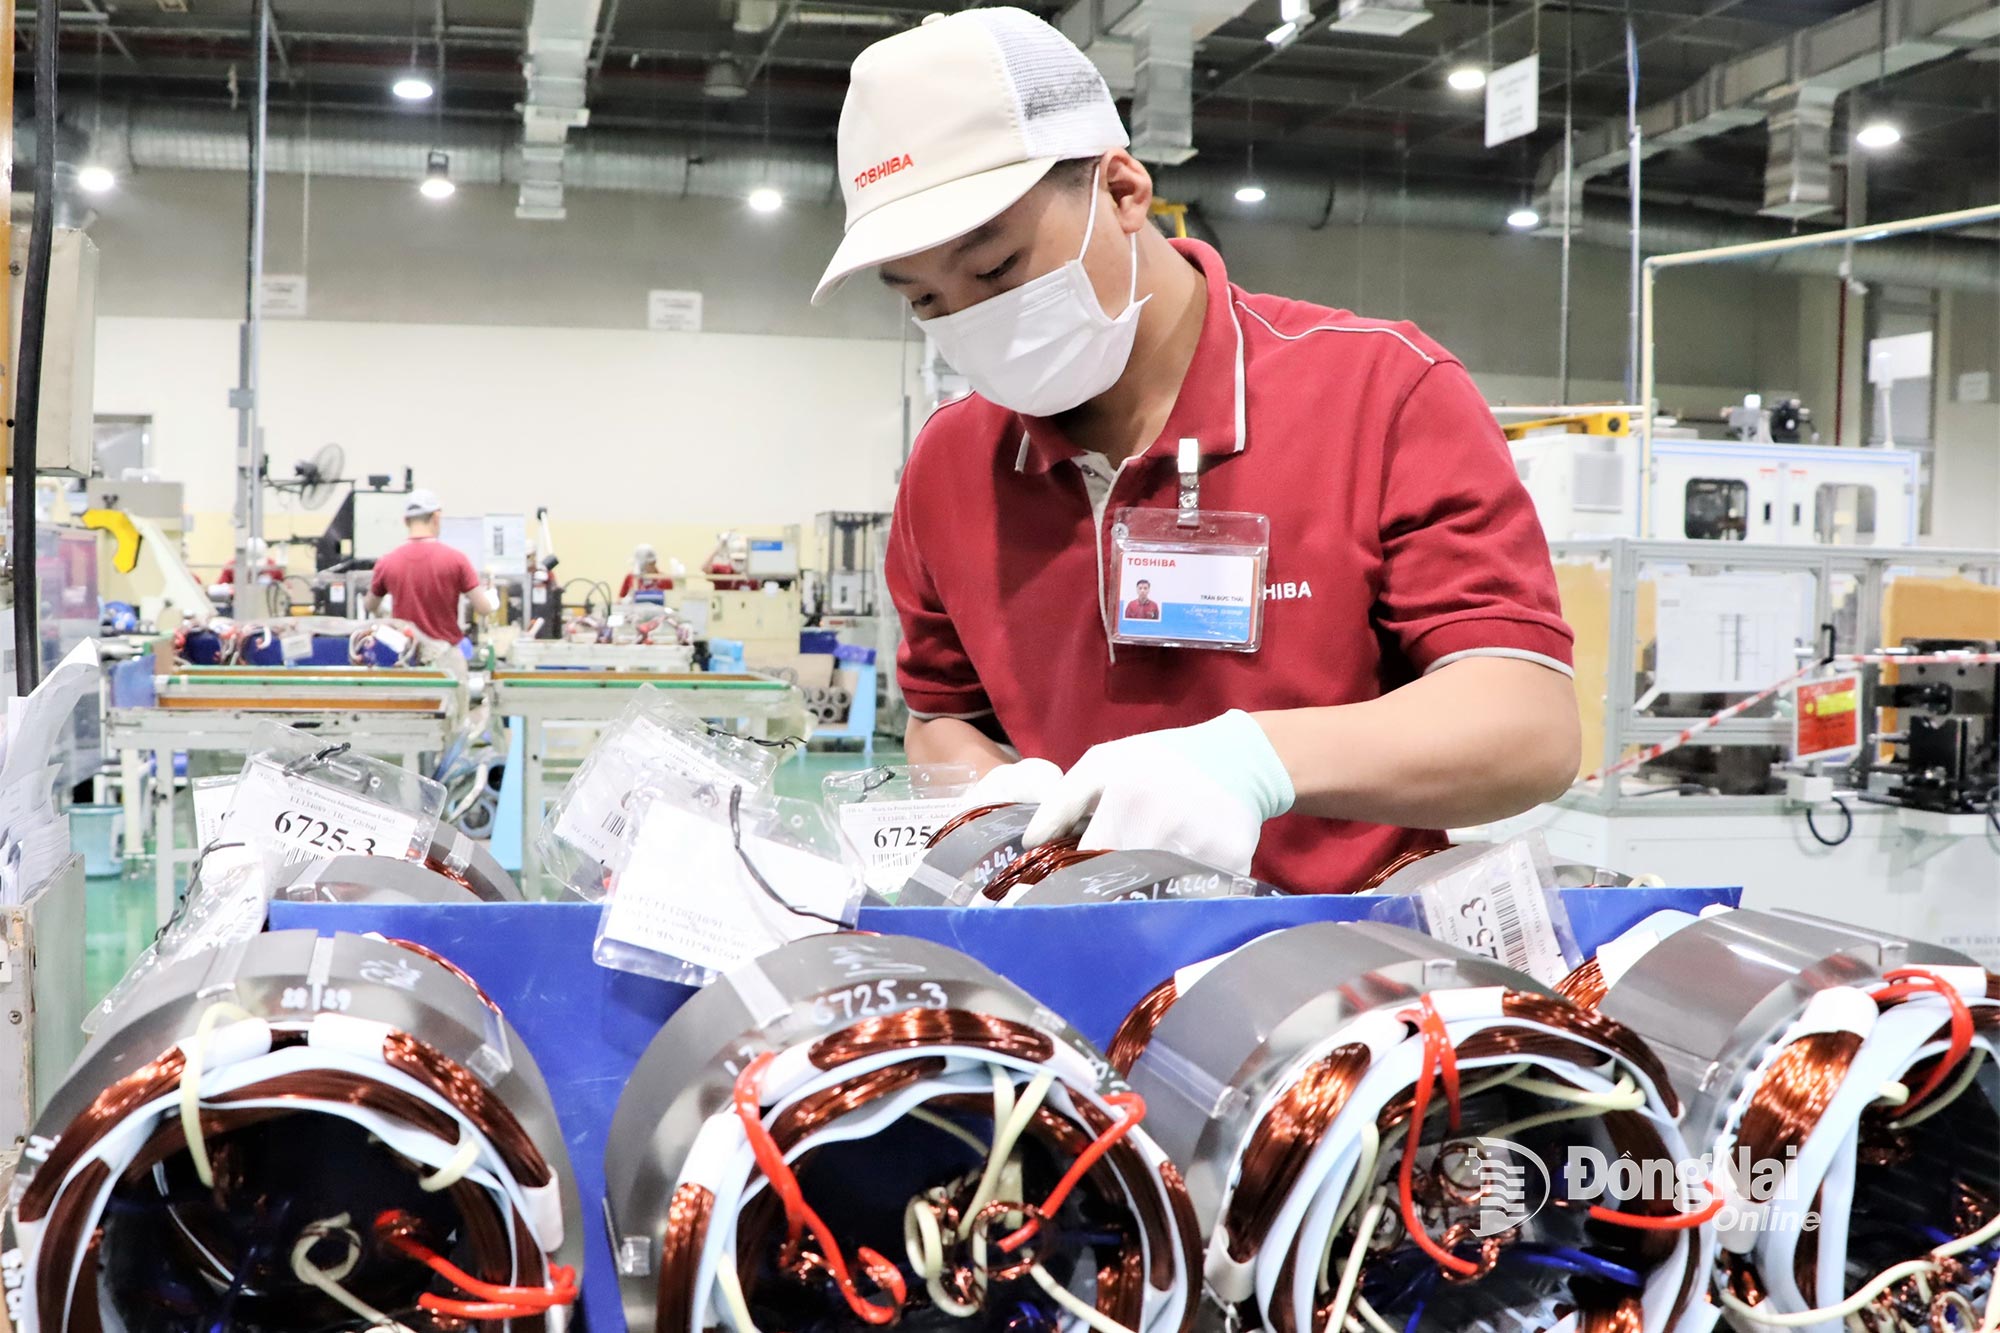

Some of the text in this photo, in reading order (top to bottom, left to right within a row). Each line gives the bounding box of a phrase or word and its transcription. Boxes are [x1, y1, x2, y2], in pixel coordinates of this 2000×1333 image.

[854, 153, 914, 191] TOSHIBA
[1127, 558, 1176, 567] TOSHIBA
[274, 810, 376, 856] 6725-3
[974, 845, 1018, 884] 4242
[812, 979, 948, 1026] 6725-3
